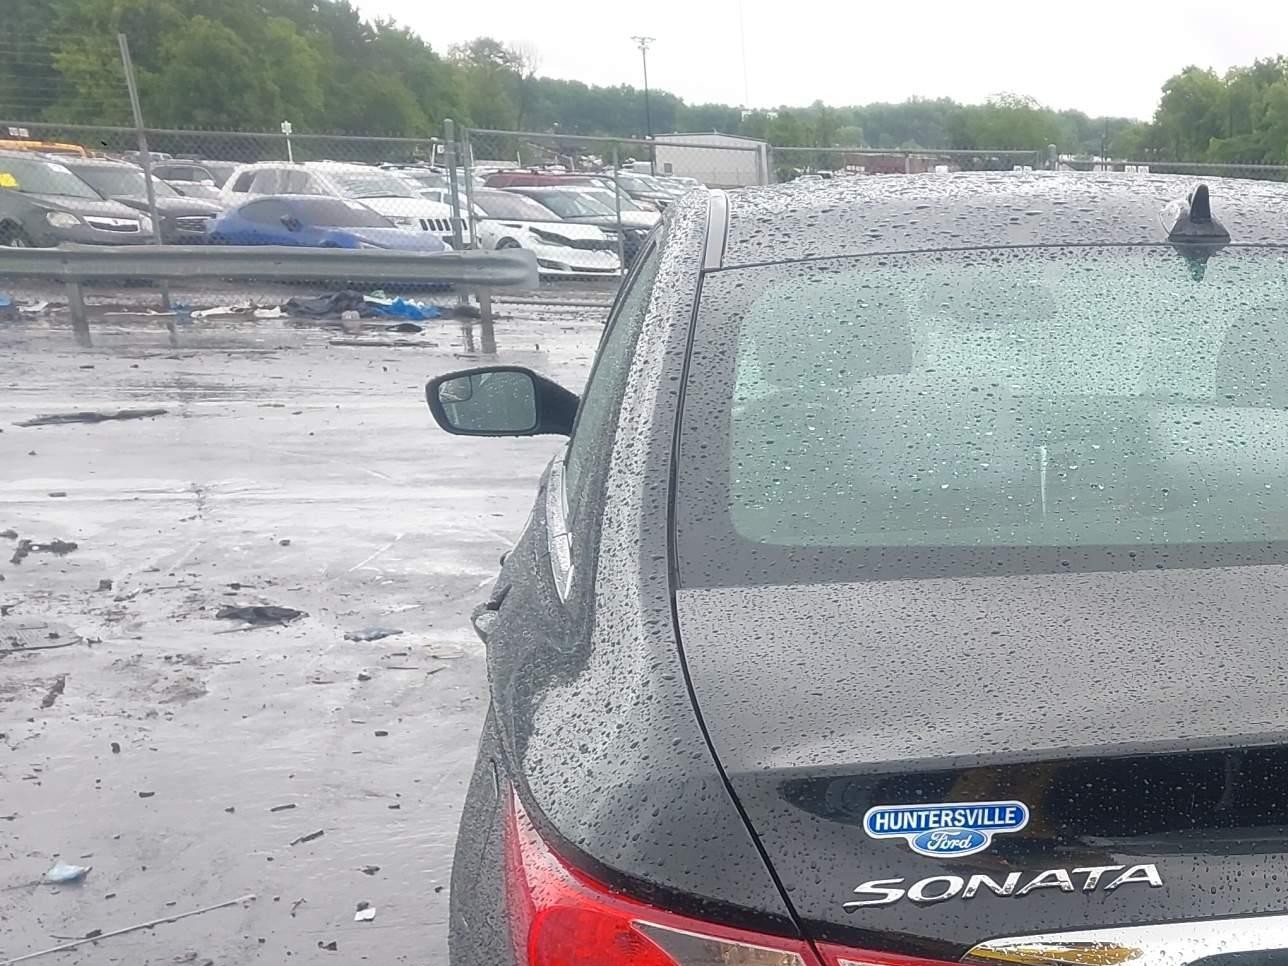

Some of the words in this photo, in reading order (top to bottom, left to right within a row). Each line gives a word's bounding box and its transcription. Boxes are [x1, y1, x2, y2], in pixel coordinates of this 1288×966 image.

[875, 807, 1017, 831] HUNTERSVILLE
[926, 830, 973, 850] Ford
[842, 862, 1164, 910] SONATA
